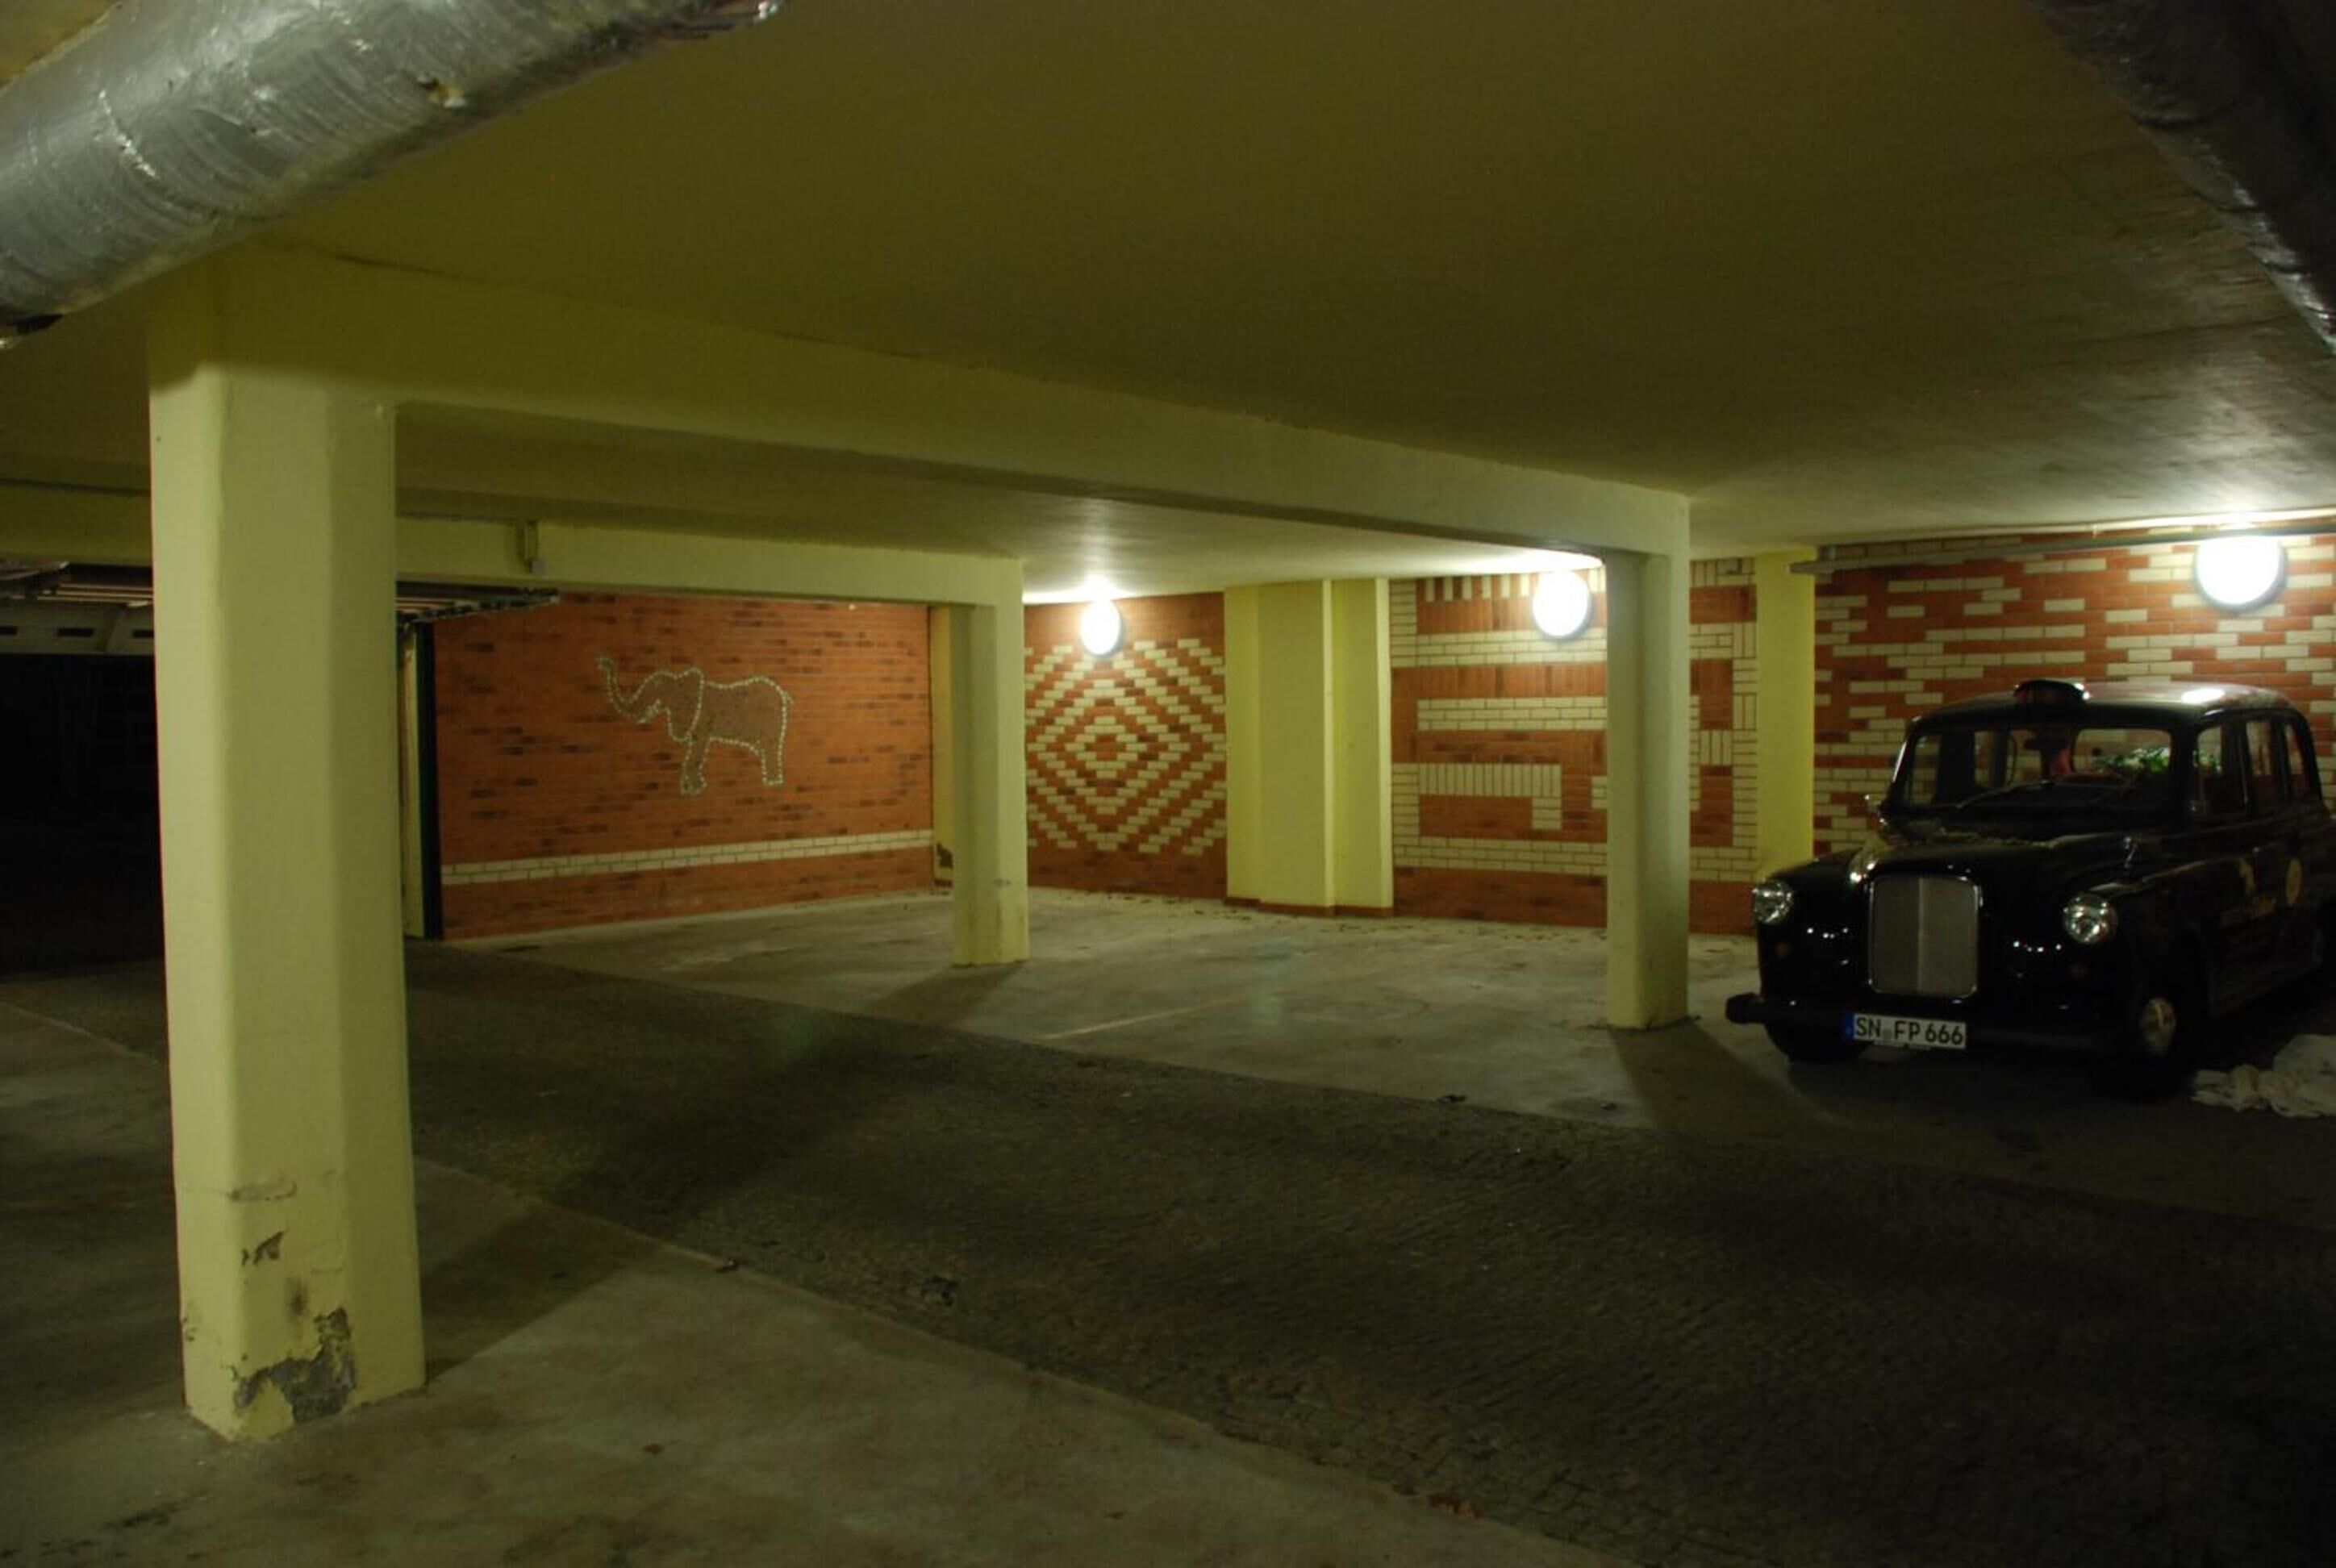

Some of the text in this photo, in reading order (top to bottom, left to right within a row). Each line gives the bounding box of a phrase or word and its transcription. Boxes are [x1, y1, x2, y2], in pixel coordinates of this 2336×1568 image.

[1855, 1017, 1963, 1045] SN FP 666
